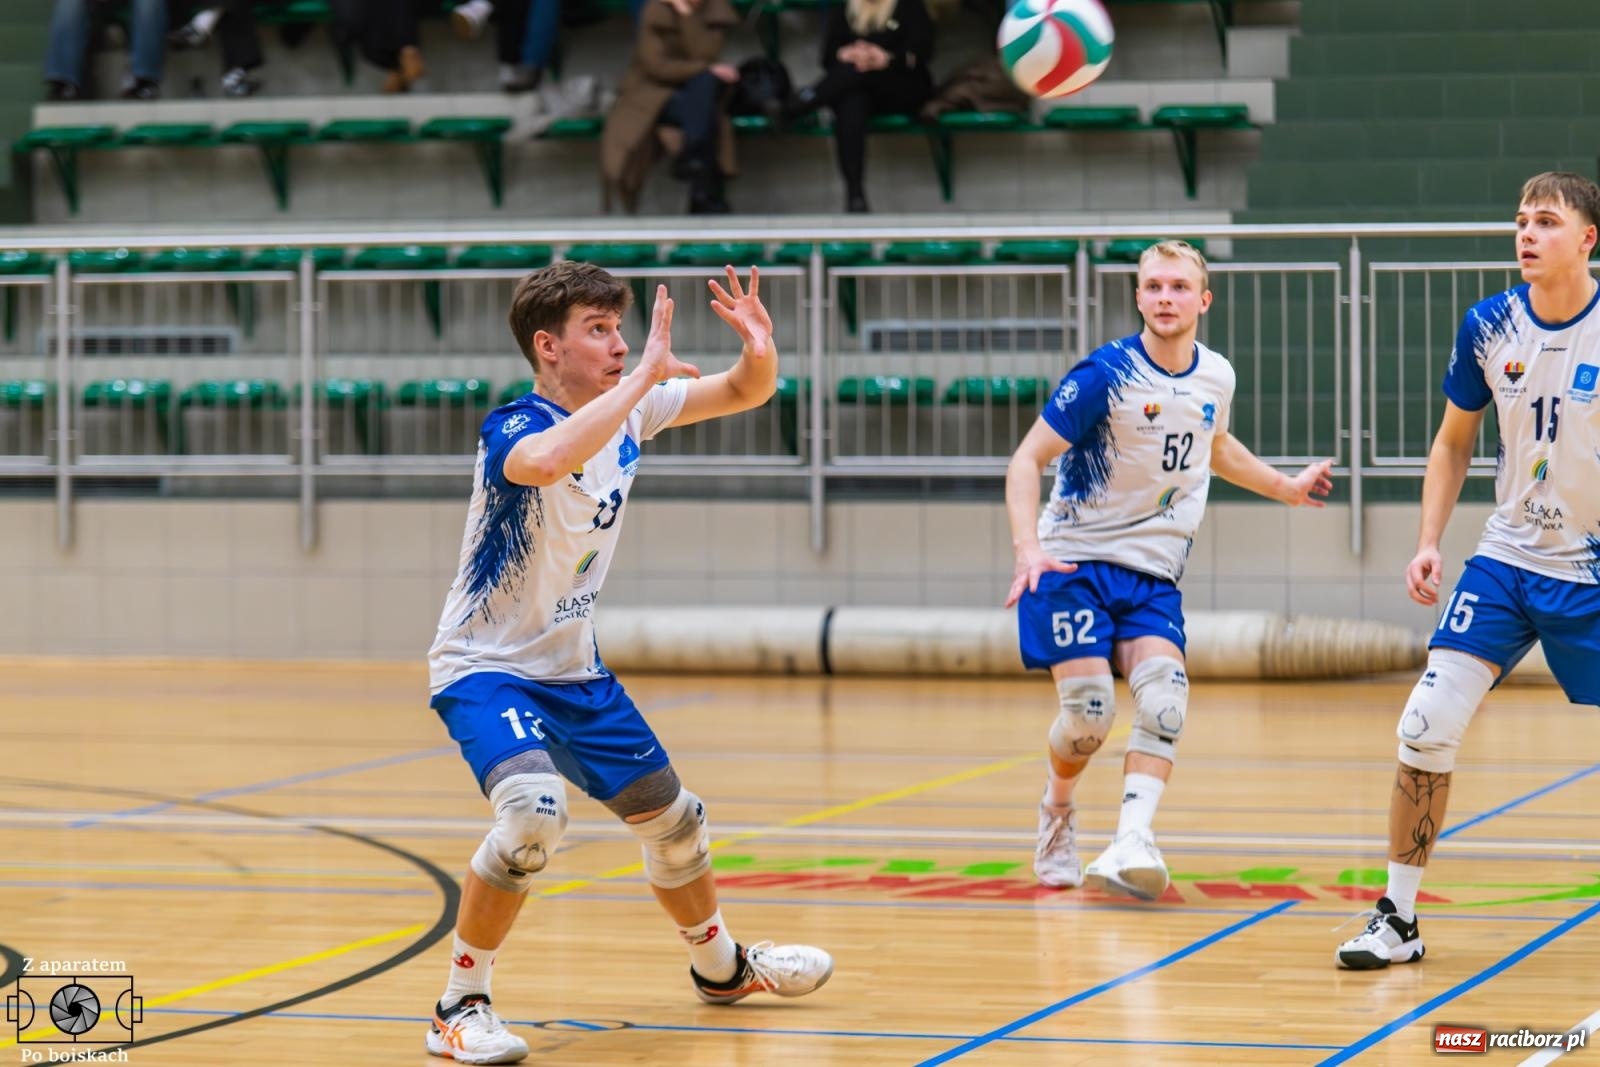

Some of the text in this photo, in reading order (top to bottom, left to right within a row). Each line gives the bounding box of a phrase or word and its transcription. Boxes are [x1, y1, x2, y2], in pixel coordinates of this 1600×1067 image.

[1531, 396, 1560, 443] 15
[1162, 432, 1194, 473] 52
[1052, 608, 1097, 647] 52
[1438, 590, 1480, 633] 15
